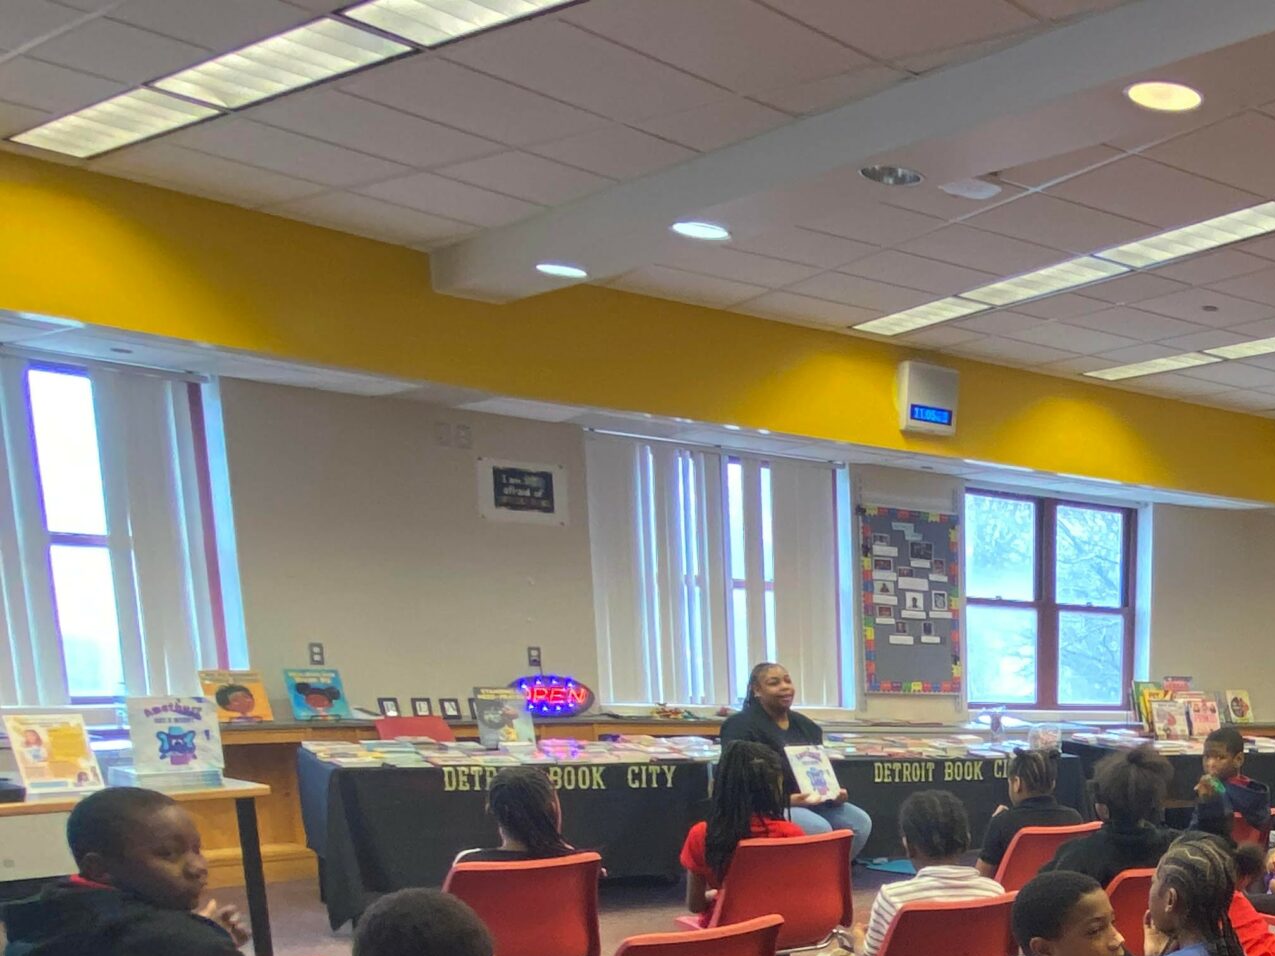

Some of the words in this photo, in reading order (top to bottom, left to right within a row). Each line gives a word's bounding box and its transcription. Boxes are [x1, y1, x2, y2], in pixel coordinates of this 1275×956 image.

[551, 766, 606, 789] BOOK
[627, 765, 677, 789] CITY
[874, 762, 934, 782] DETROIT
[944, 761, 984, 780] BOOK
[993, 759, 1008, 779] CI
